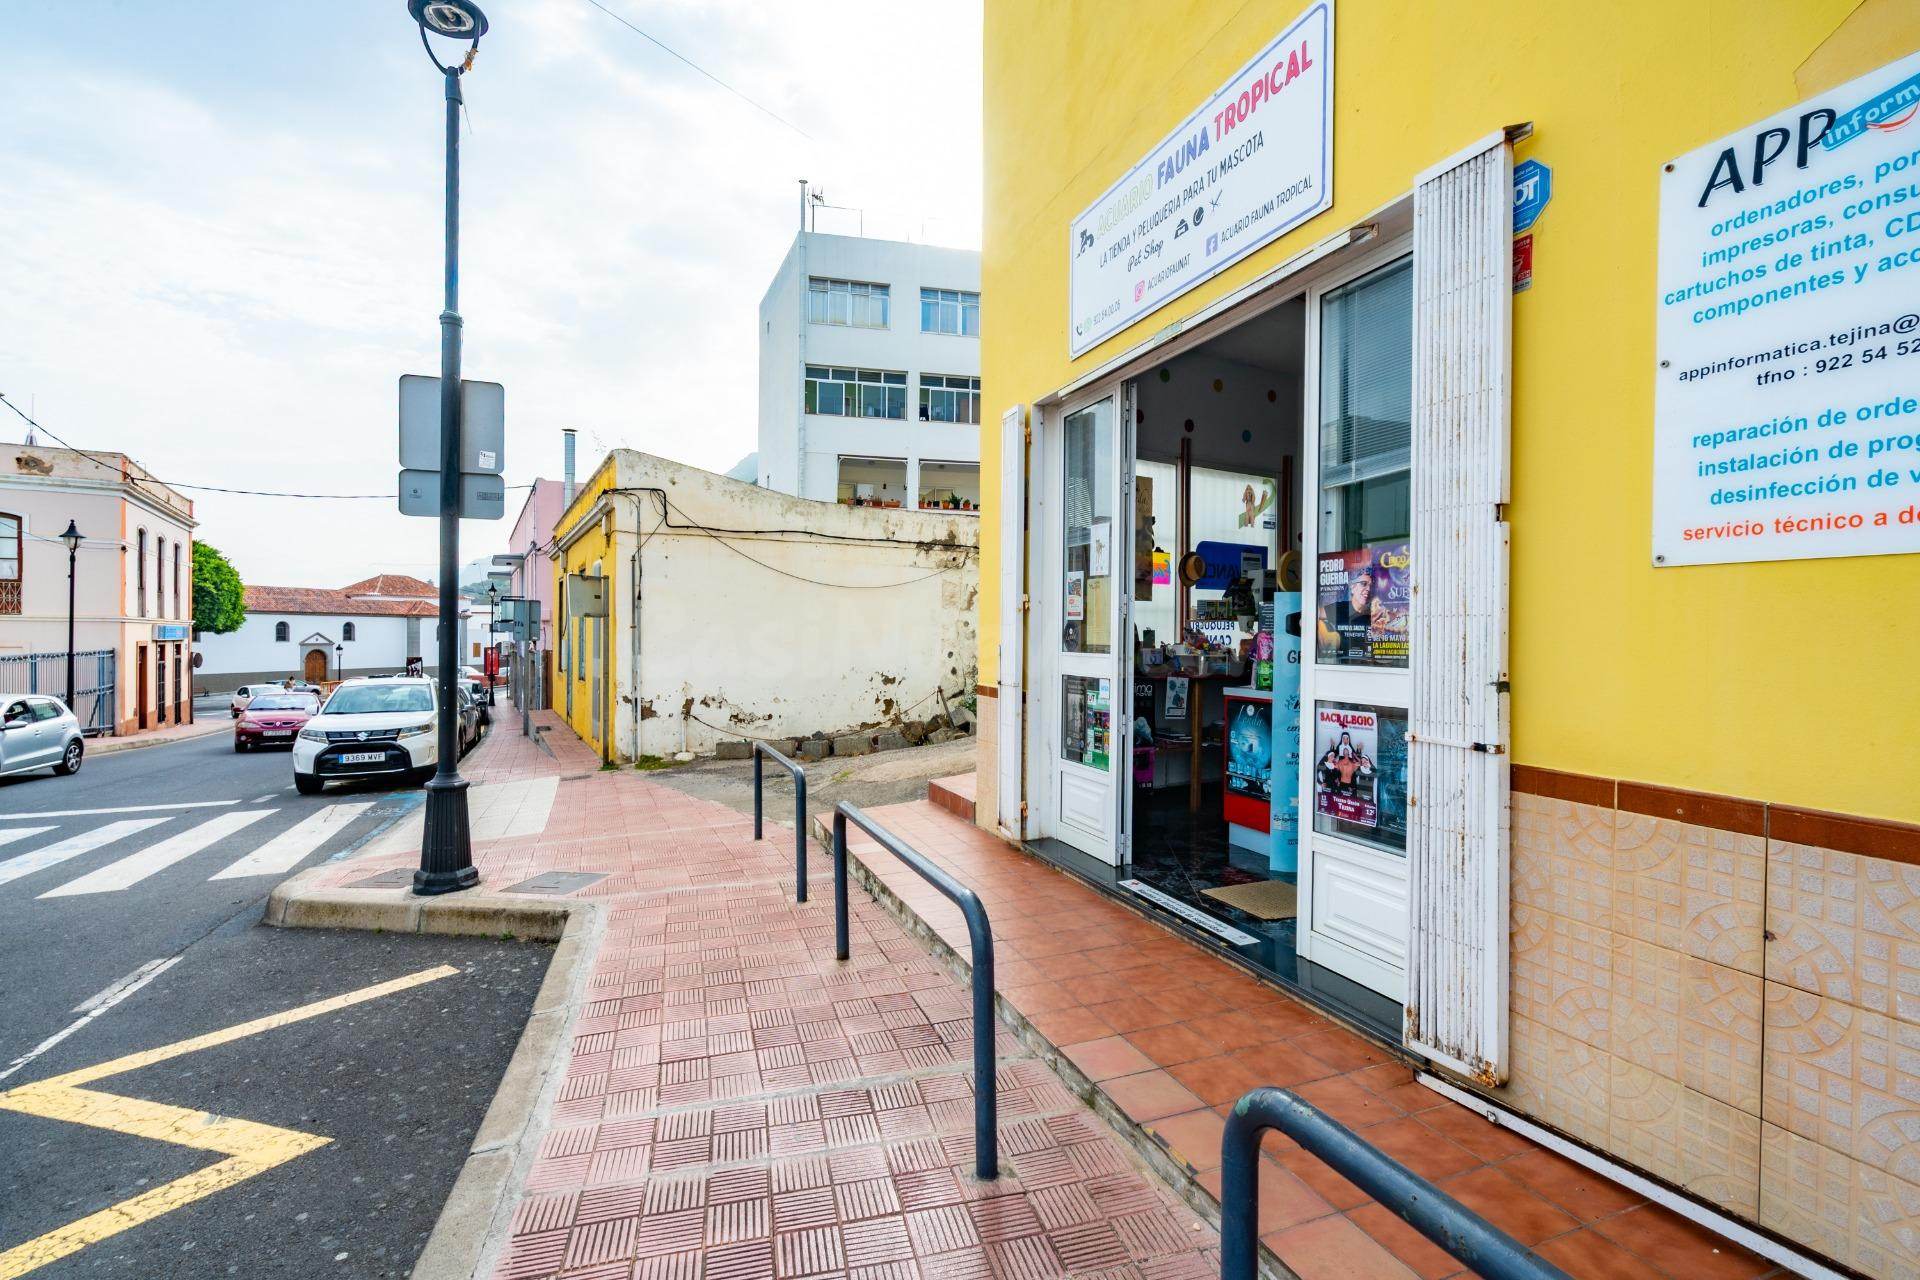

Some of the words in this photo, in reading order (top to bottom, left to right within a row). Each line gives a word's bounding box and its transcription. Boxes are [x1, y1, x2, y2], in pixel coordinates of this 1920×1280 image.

[1157, 126, 1210, 190] FAUNA
[1214, 40, 1313, 142] TROPICAL
[1697, 108, 1837, 208] APP
[1100, 251, 1107, 268] LA
[1109, 233, 1131, 259] TIENDA
[1132, 230, 1137, 243] Y
[1138, 194, 1181, 237] PELUQUERIA
[1183, 176, 1204, 206] PARA
[1207, 165, 1218, 188] TU
[1220, 130, 1264, 178] MASCOTA
[1220, 215, 1250, 245] ACUARIO
[1251, 200, 1274, 225] FAUNA
[1276, 174, 1313, 208] TROPICAL
[1513, 178, 1539, 208] DT
[1711, 173, 1863, 237] ordenadores,
[1143, 239, 1164, 258] Shop
[1702, 214, 1834, 268] impresoras,
[1147, 253, 1191, 291] ACUARIOFAUNAT
[1664, 263, 1767, 306] cartuchos
[1774, 253, 1803, 273] de
[1810, 231, 1874, 261] tinta,
[1692, 269, 1845, 324] componentes
[1854, 261, 1869, 283] y
[1679, 314, 1920, 381] appinformatica.tejina@
[1756, 369, 1795, 386] tfno
[1816, 353, 1853, 374] 922
[1861, 345, 1888, 364] 54
[1897, 338, 1920, 357] 52
[1692, 415, 1808, 449] reparación
[1817, 408, 1847, 428] de
[1698, 446, 1819, 477] instalación
[1828, 440, 1858, 459] de
[1710, 473, 1857, 505] desinfección
[1867, 469, 1899, 488] de
[1683, 519, 1764, 541] servicio
[1773, 512, 1863, 534] técnico
[1873, 510, 1888, 526] a
[1320, 559, 1344, 572] PEDRO
[1320, 572, 1349, 585] GUERRA
[344, 754, 366, 762] 9369
[367, 753, 383, 761] MVF
